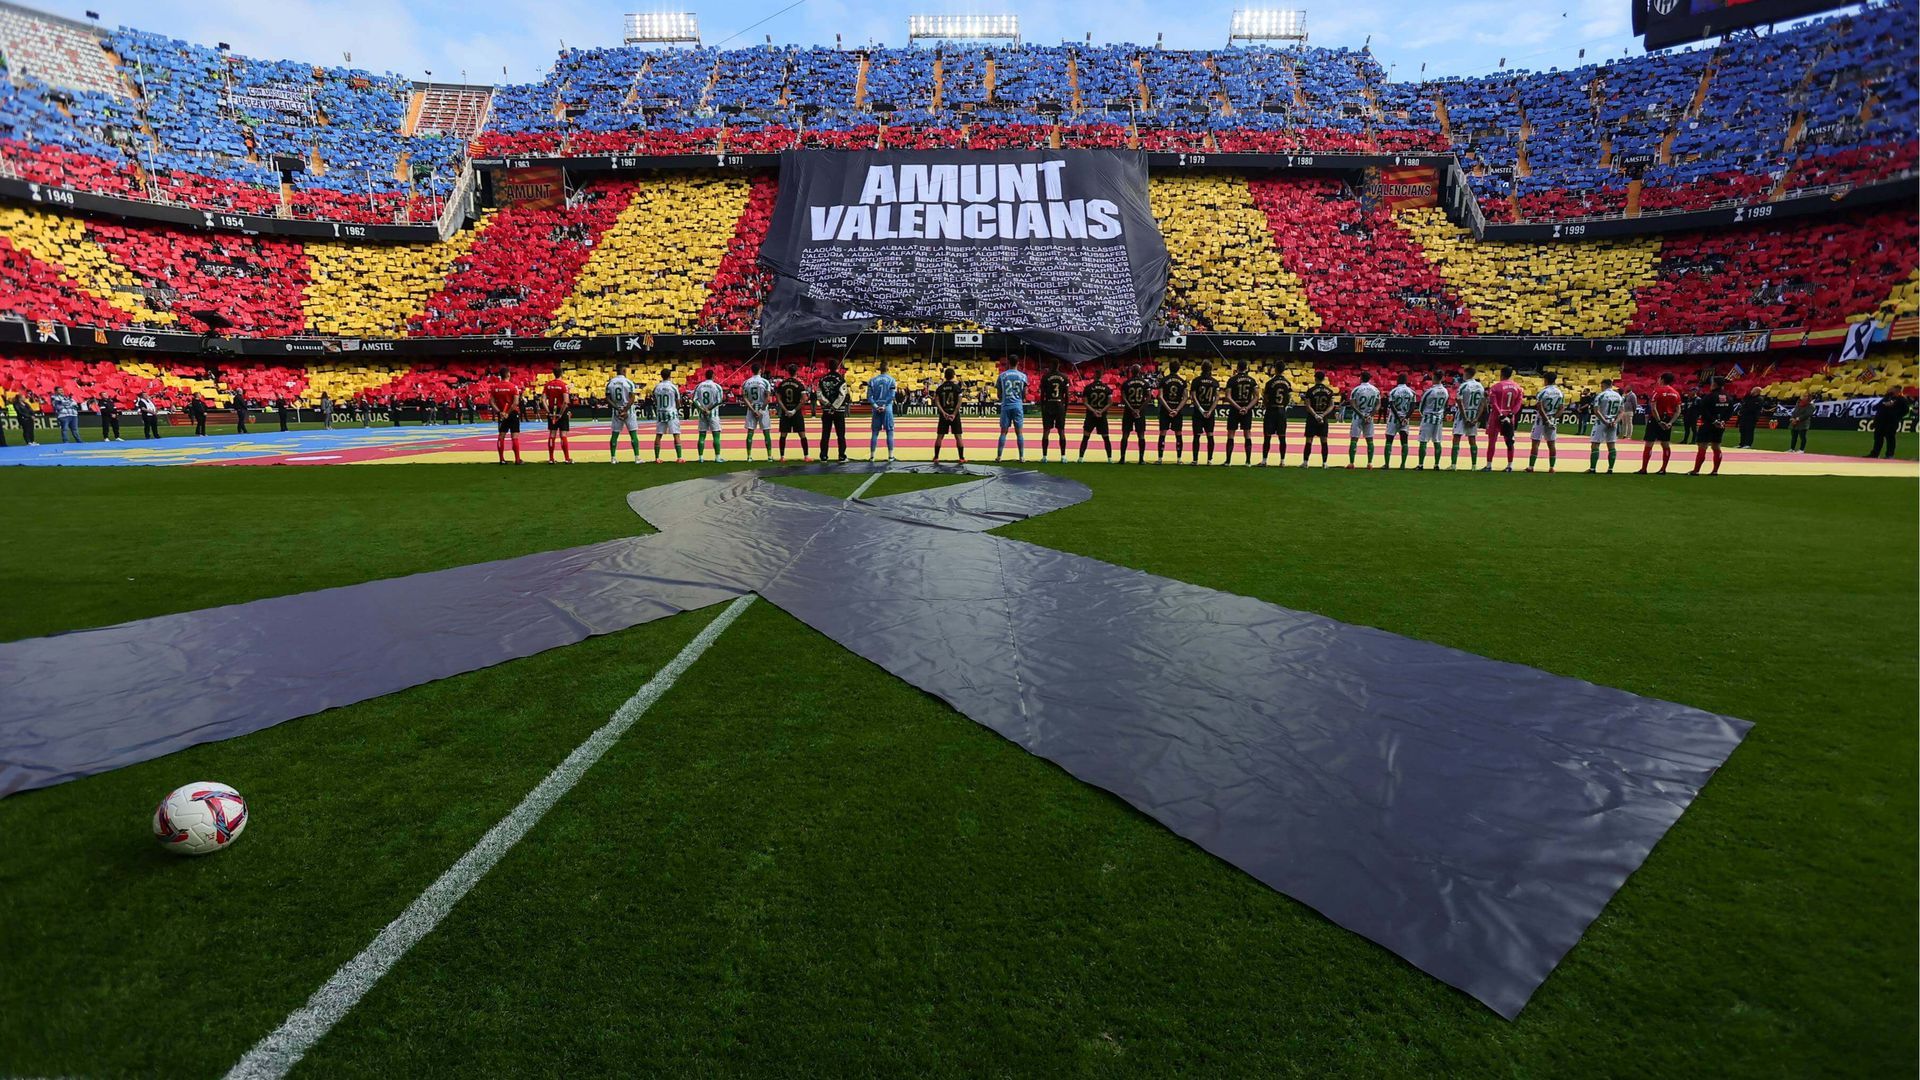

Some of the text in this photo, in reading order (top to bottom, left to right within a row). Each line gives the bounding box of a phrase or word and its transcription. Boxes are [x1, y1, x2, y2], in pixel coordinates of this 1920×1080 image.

[621, 158, 636, 166] 1967
[728, 156, 742, 164] 1971
[1189, 156, 1205, 164] 1979
[1297, 156, 1313, 165] 1980
[1404, 158, 1419, 166] 1980
[1624, 156, 1650, 164] AMSTEL
[859, 160, 1066, 204] AMUNT
[46, 188, 74, 204] 1949
[506, 184, 551, 200] AMUNT
[1370, 184, 1431, 196] VALENCIANS
[1747, 206, 1772, 218] 1999
[220, 216, 244, 228] 1954
[810, 199, 1122, 240] VALENCIANS
[345, 225, 366, 236] 1962
[1564, 225, 1585, 234] 1999
[978, 300, 1018, 309] PICANYA
[362, 342, 394, 351] AMSTEL
[884, 337, 908, 345] PUMA
[1627, 340, 1641, 356] LA
[1644, 338, 1684, 356] CURVA
[615, 387, 622, 401] 6
[751, 387, 758, 401] 5
[1005, 380, 1021, 395] 25
[1052, 383, 1059, 398] 3
[657, 394, 669, 408] 10
[703, 391, 710, 405] 8
[786, 388, 793, 403] 9
[1359, 395, 1375, 410] 24
[1507, 392, 1512, 407] 1
[1608, 400, 1620, 415] 15
